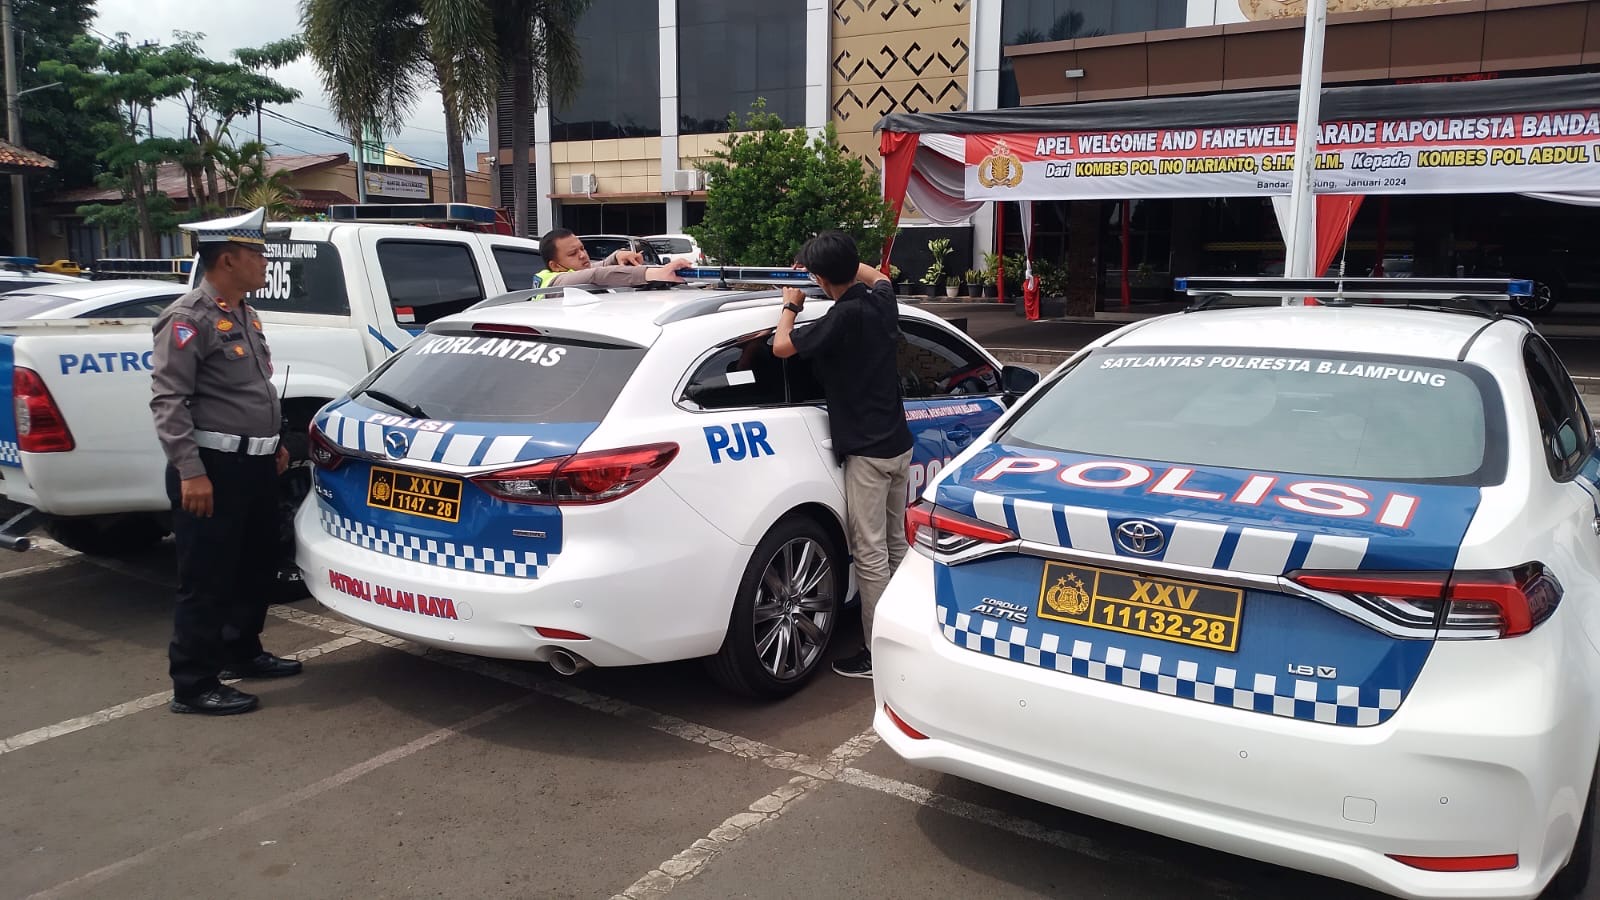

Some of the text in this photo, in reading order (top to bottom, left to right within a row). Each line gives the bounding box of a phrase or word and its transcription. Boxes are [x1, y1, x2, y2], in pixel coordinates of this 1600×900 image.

[1036, 112, 1600, 156] APEL WELCOME AND FAREWELL ARADE KAPOLRESTA BANDA
[1046, 163, 1071, 177] Dari
[1075, 161, 1128, 177] KOMBES
[1130, 160, 1156, 176] POL
[1159, 159, 1184, 175] INO
[1185, 155, 1258, 174] HARIANTO,
[1262, 154, 1295, 171] S.I.K
[1351, 152, 1411, 171] Kepada
[1417, 149, 1488, 168] KOMBES
[1491, 148, 1526, 165] POL
[1528, 145, 1590, 164] ABDUL
[1257, 181, 1289, 189] Bandar
[1345, 178, 1381, 188] Januari
[1383, 178, 1407, 187] 2024
[262, 243, 282, 258] RESTA
[246, 261, 291, 300] 505
[59, 351, 154, 375] PATRO
[415, 336, 567, 367] KORLANTAS
[1100, 355, 1446, 387] SATLANTAS POLRESTA B.LAMPUNG
[366, 412, 456, 433] POLISI
[703, 420, 775, 464] PJR
[409, 477, 443, 497] XXV
[971, 455, 1422, 529] POLISI
[398, 495, 425, 511] 1147
[328, 569, 458, 620] PATROLI JALAN RAYA
[981, 597, 1028, 613] COROLLA
[1129, 580, 1199, 610] XXV
[970, 604, 1028, 623] ALTIS
[1103, 604, 1225, 643] 11132-28
